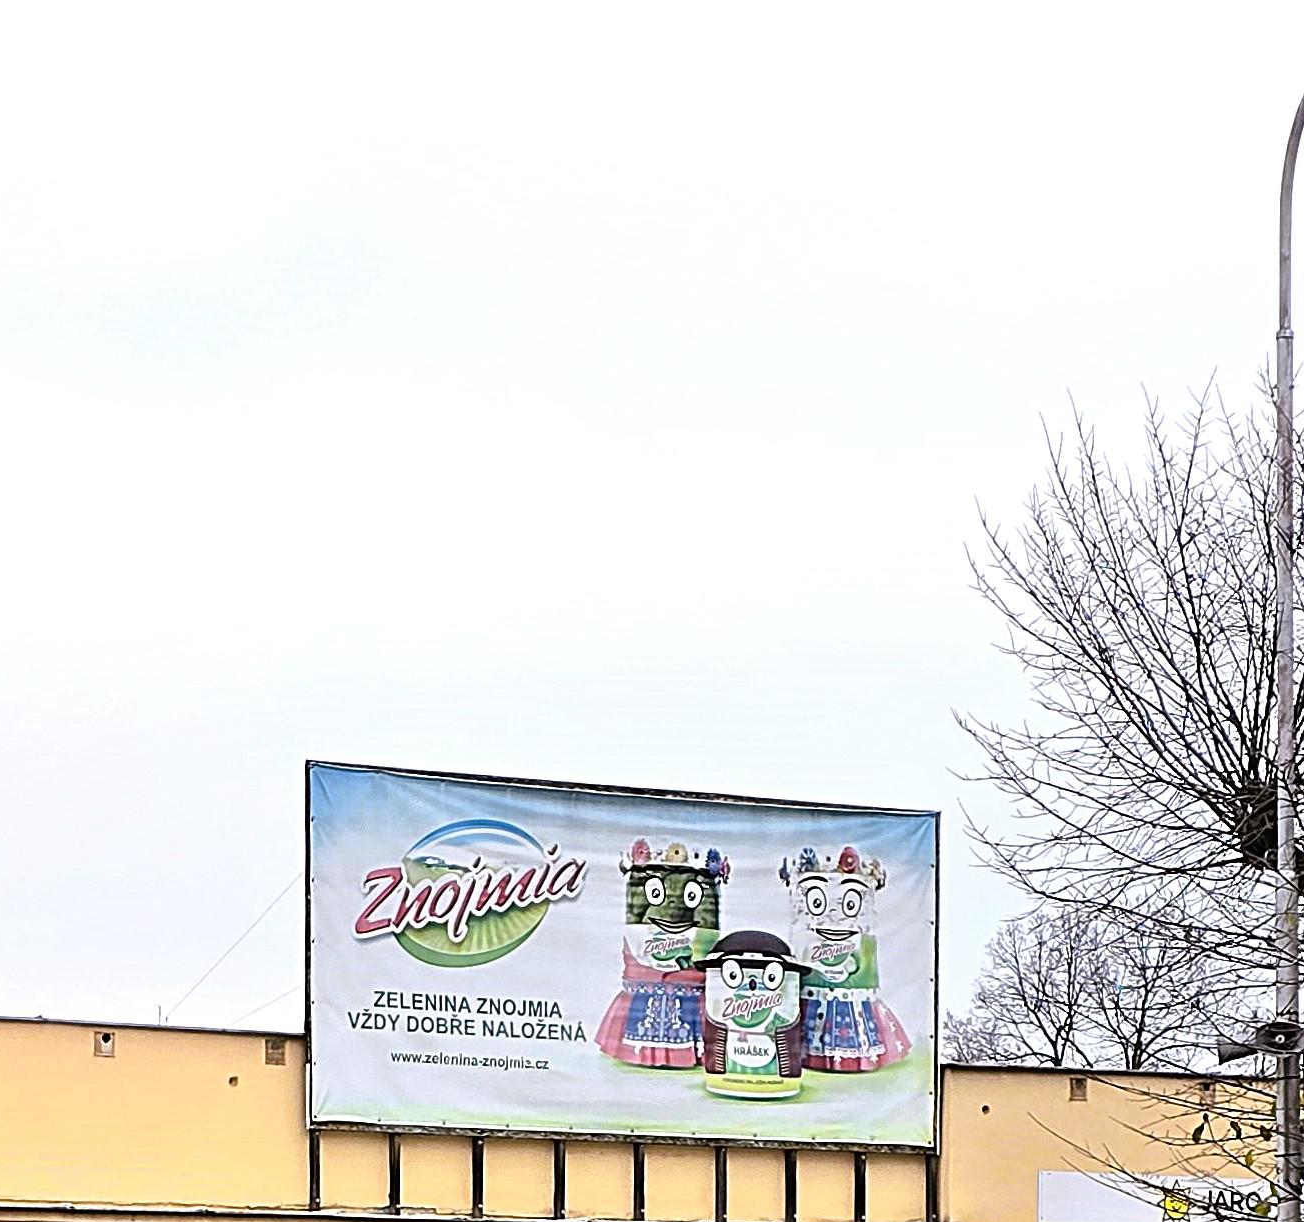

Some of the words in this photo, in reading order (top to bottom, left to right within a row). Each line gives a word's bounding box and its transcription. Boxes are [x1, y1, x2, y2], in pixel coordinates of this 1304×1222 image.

[354, 843, 588, 939] Znojmia
[373, 990, 472, 1014] ZELENINA
[476, 997, 563, 1019] ZNOJMIA
[722, 991, 783, 1020] Znojmia
[347, 1008, 401, 1032] VŽDY
[406, 1013, 476, 1037] DOBŘE
[482, 1018, 587, 1043] NALOŽENÁ
[390, 1051, 550, 1071] www.zelenina-znojmia.cz
[733, 1044, 770, 1057] HRÁŠEK
